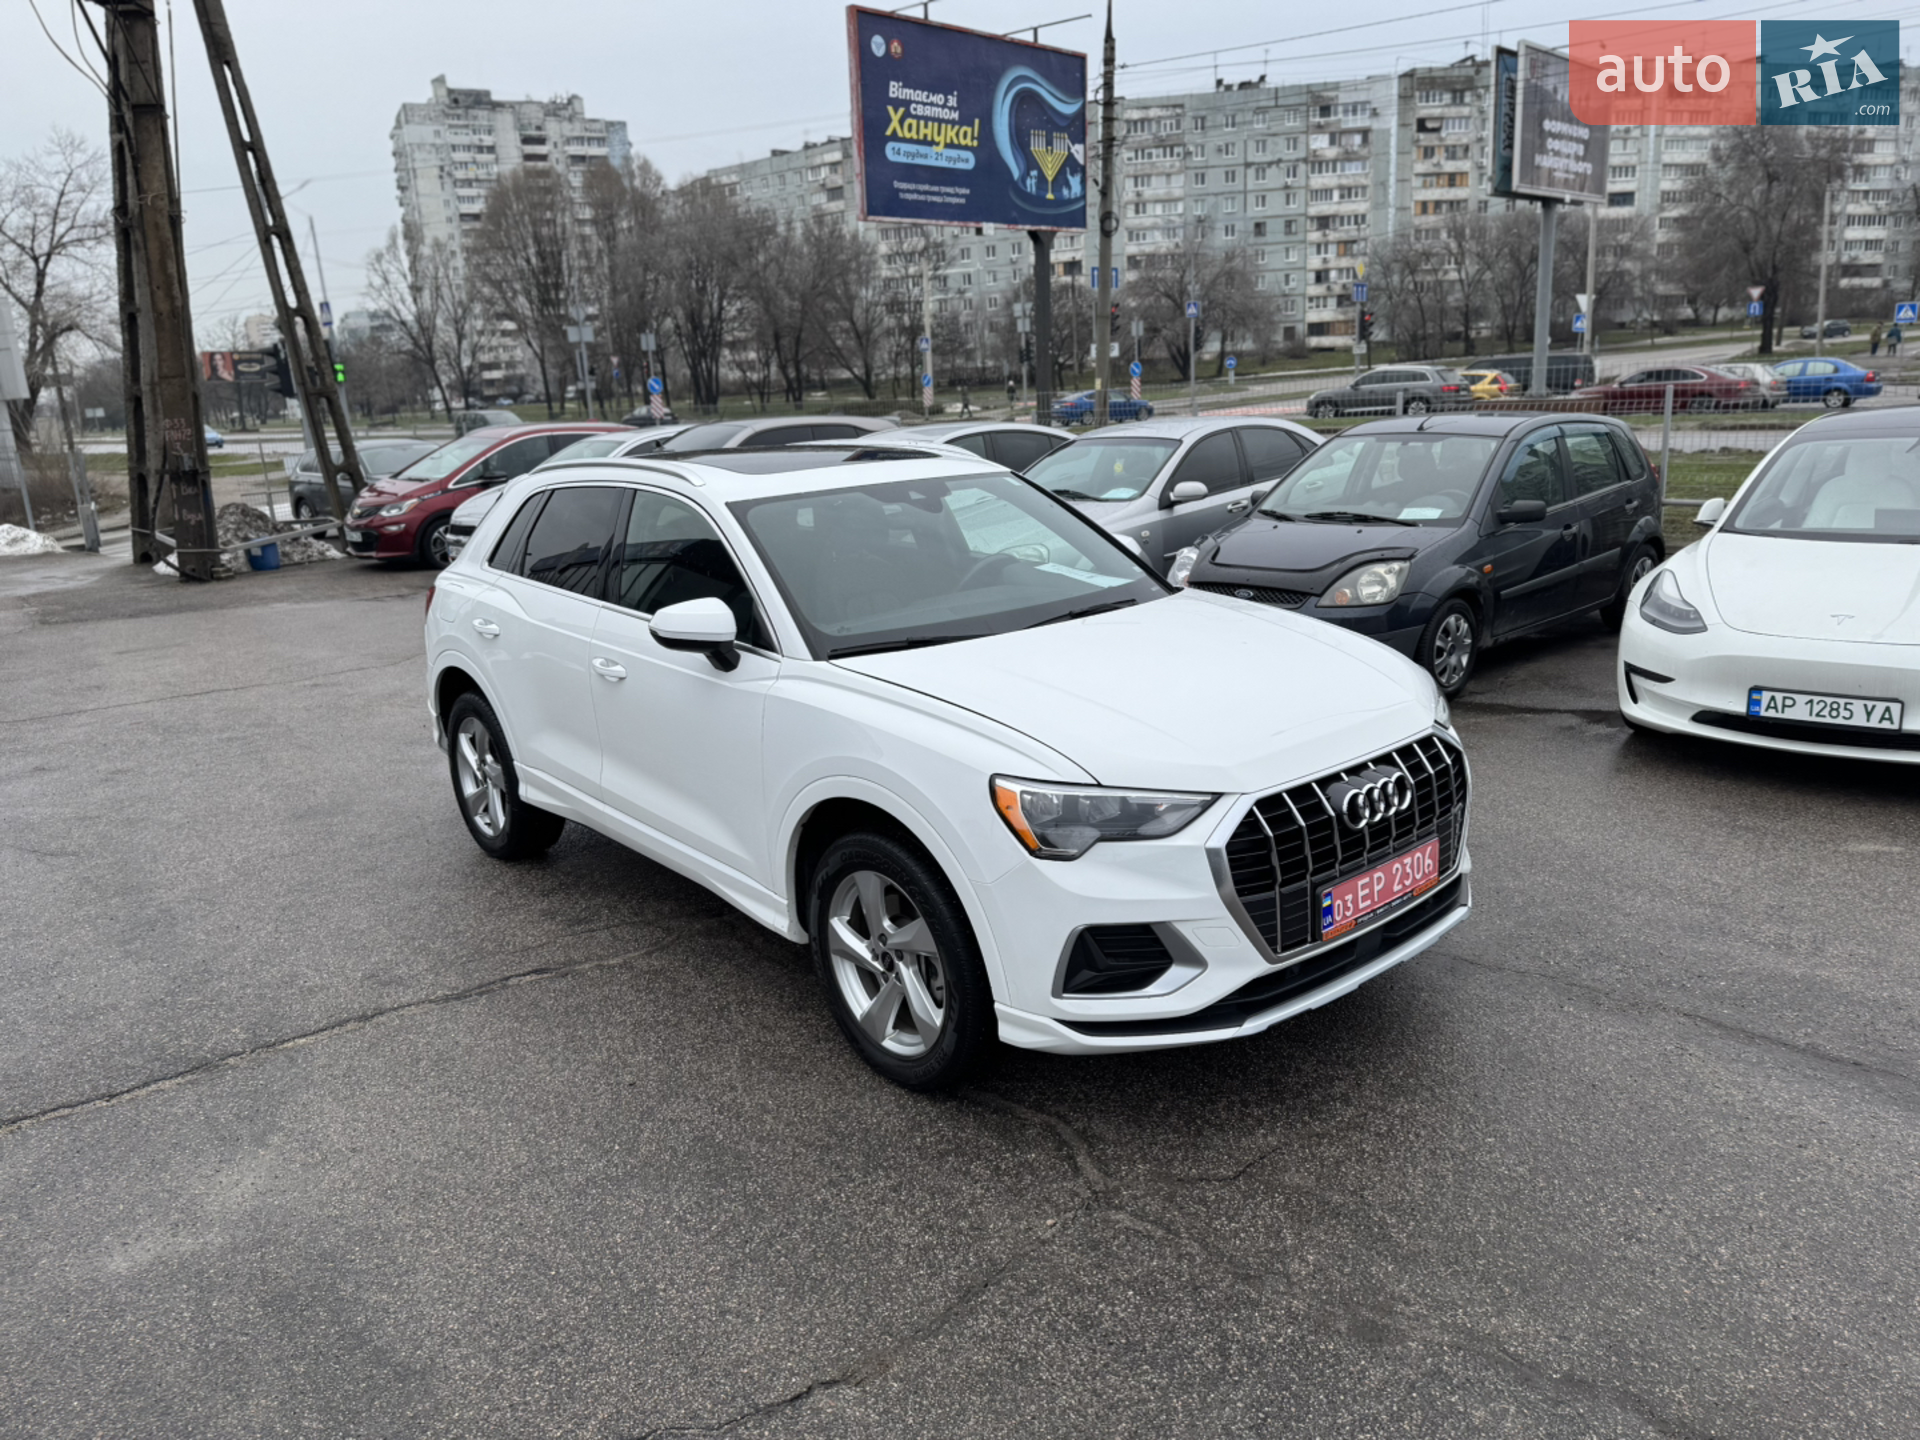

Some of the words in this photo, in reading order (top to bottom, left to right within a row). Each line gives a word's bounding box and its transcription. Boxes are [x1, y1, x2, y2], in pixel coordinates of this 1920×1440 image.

[889, 81, 944, 105] Вітаємо
[946, 90, 958, 108] зі
[910, 103, 959, 120] святом
[885, 105, 979, 150] Ханука!
[891, 147, 901, 156] 14
[1764, 694, 1797, 715] AP
[1804, 698, 1854, 721] 1285
[1862, 703, 1895, 725] YA
[1335, 894, 1354, 922] 03
[1358, 872, 1384, 909] EP
[1392, 846, 1433, 893] 2306
